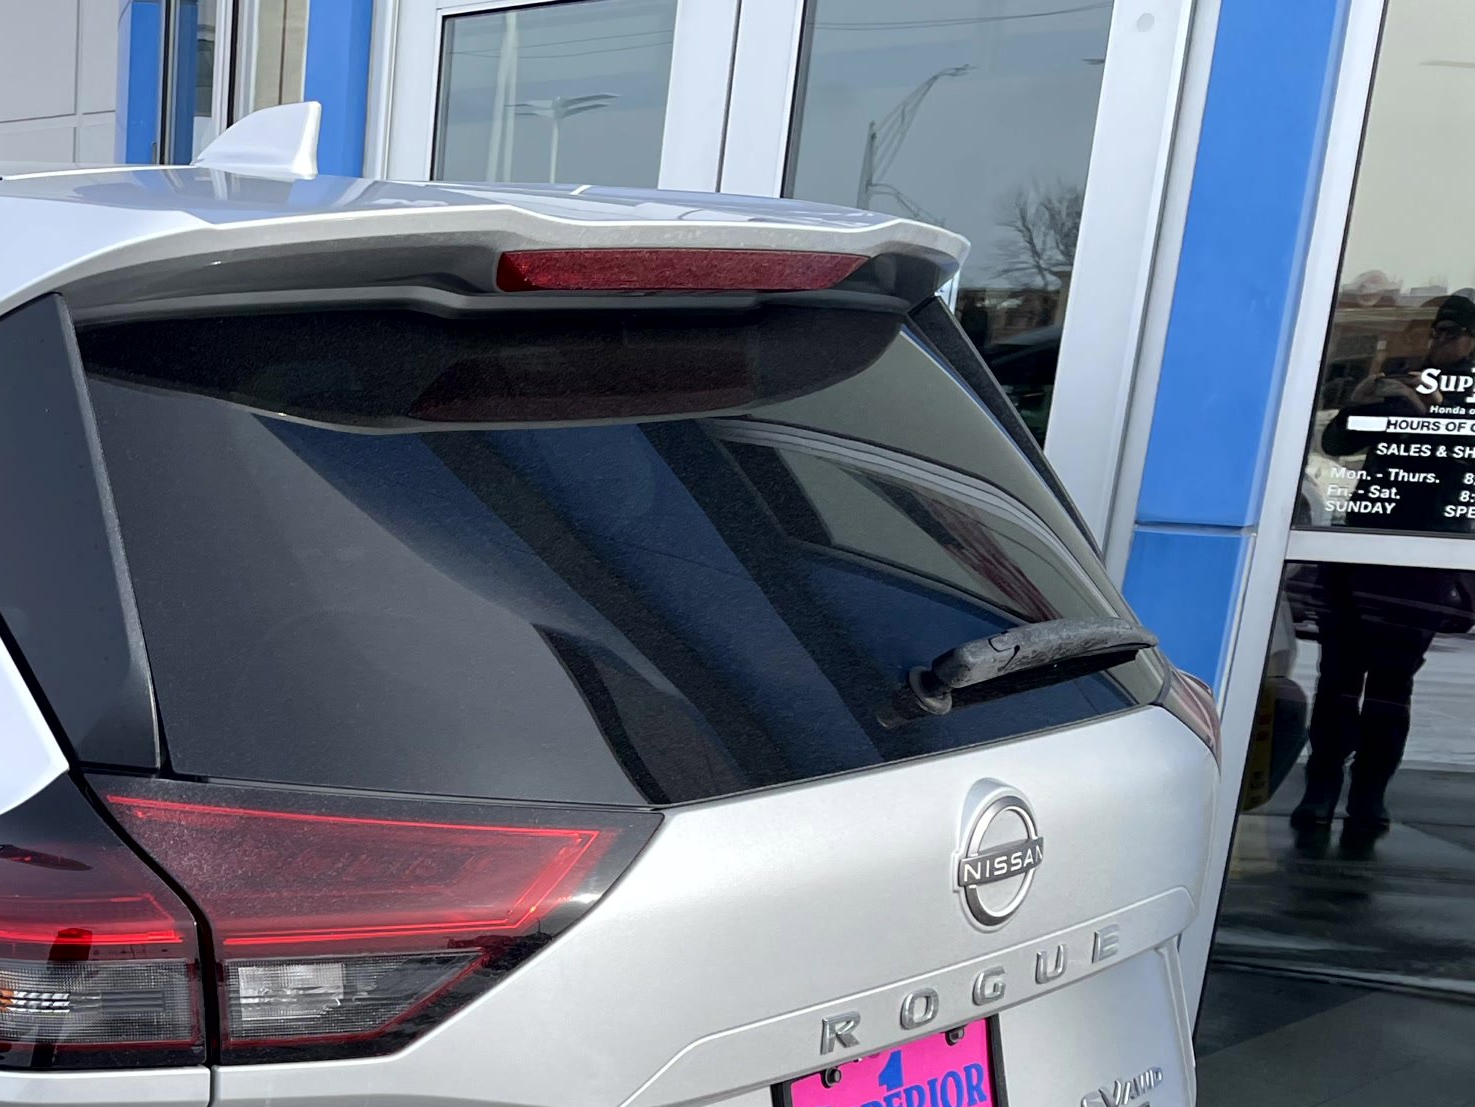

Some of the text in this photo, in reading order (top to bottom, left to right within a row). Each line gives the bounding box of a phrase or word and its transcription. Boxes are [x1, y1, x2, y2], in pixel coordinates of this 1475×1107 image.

[1430, 405, 1466, 415] Honda
[1386, 419, 1441, 431] HOURS
[1445, 421, 1467, 432] OF
[1376, 442, 1432, 457] SALES
[1435, 445, 1448, 458] &
[1331, 467, 1371, 481] Mon.
[1388, 468, 1440, 484] Thurs.
[1327, 484, 1352, 497] Fri.
[1368, 485, 1400, 499] Sat.
[1325, 500, 1475, 518] SUNDAY SPE
[964, 845, 1043, 882] NISSAN
[820, 924, 1122, 1055] ROGUE
